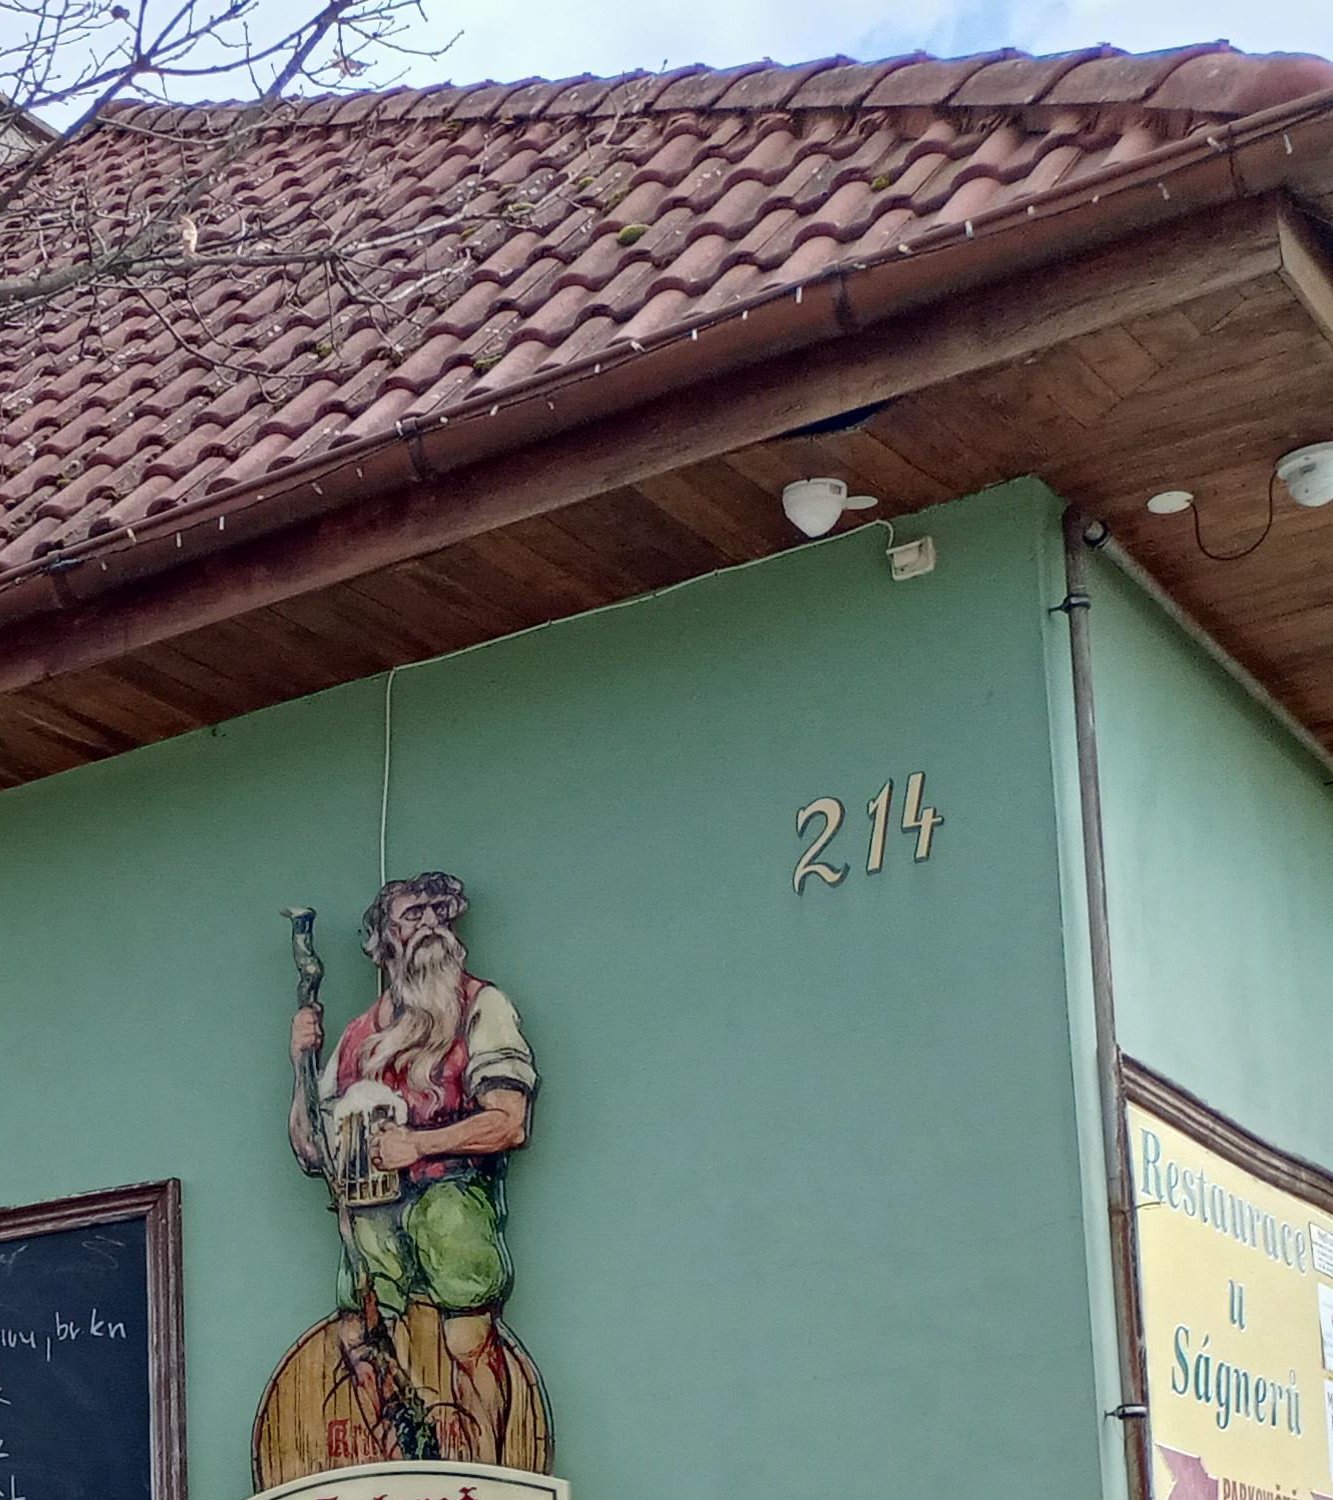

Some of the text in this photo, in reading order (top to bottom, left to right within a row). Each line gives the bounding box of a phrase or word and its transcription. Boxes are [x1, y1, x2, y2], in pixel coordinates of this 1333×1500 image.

[792, 770, 944, 896] 214
[1139, 1127, 1308, 1277] Restaurace
[1227, 1277, 1247, 1331] u
[1171, 1324, 1303, 1438] Ságnerů
